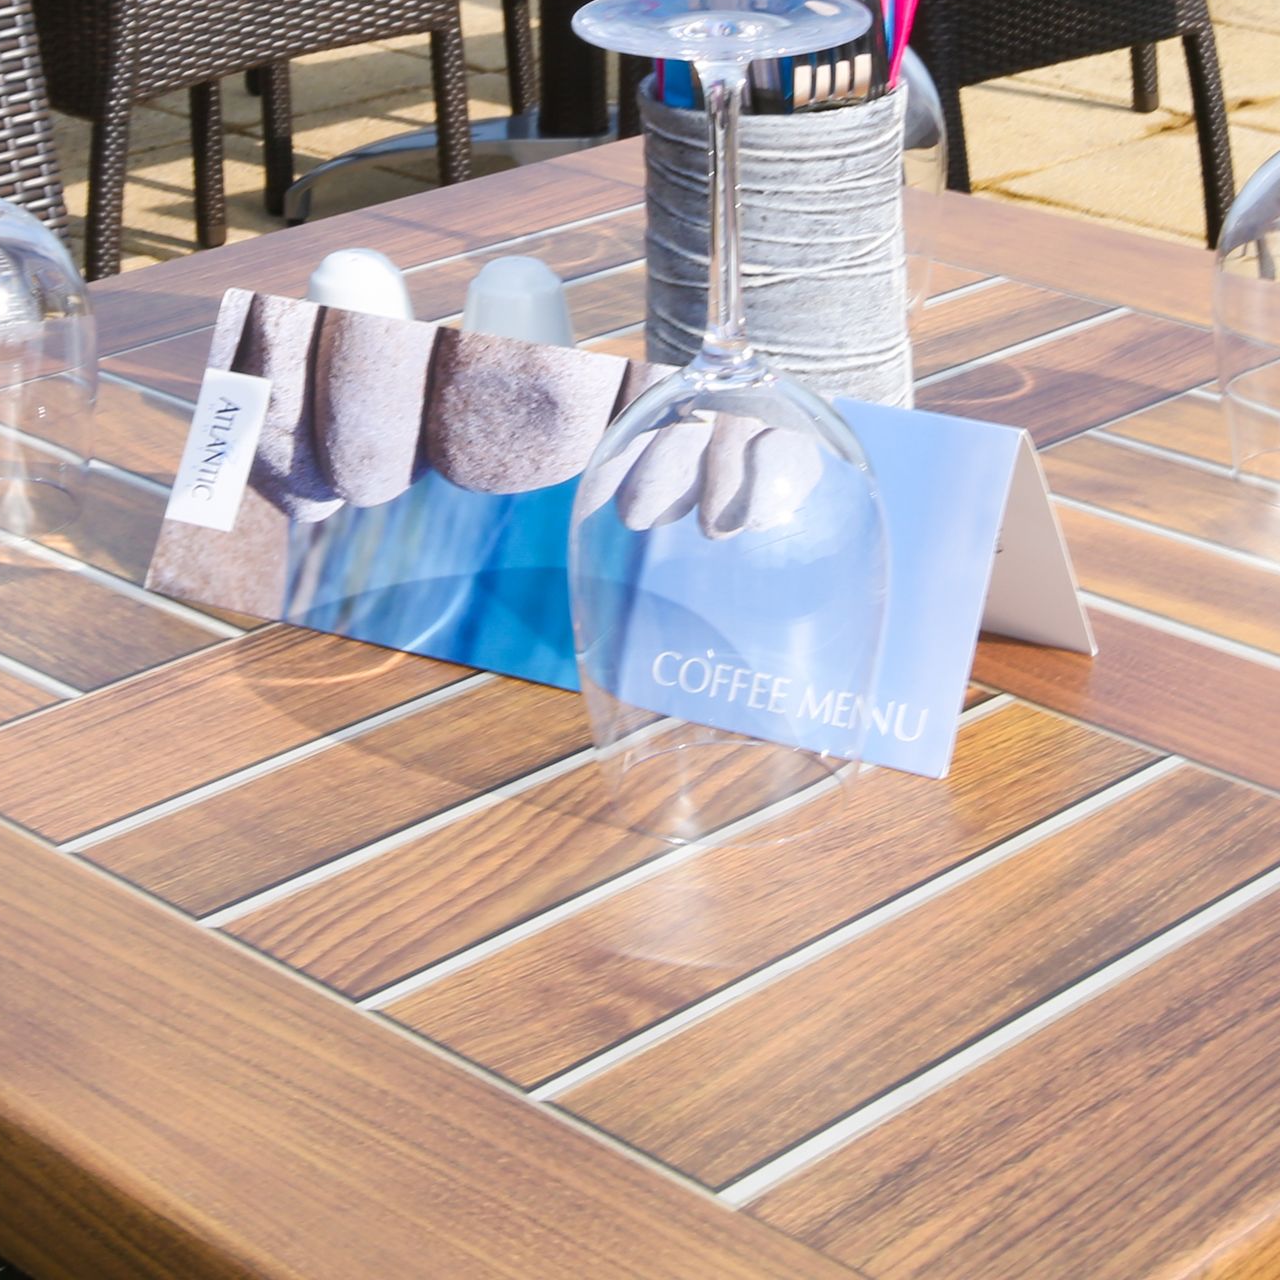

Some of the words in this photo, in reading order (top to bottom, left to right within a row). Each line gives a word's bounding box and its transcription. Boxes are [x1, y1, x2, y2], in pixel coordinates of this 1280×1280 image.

[191, 396, 241, 502] ATLANTIC
[652, 650, 792, 714] COFFEE
[796, 684, 929, 742] MENU
